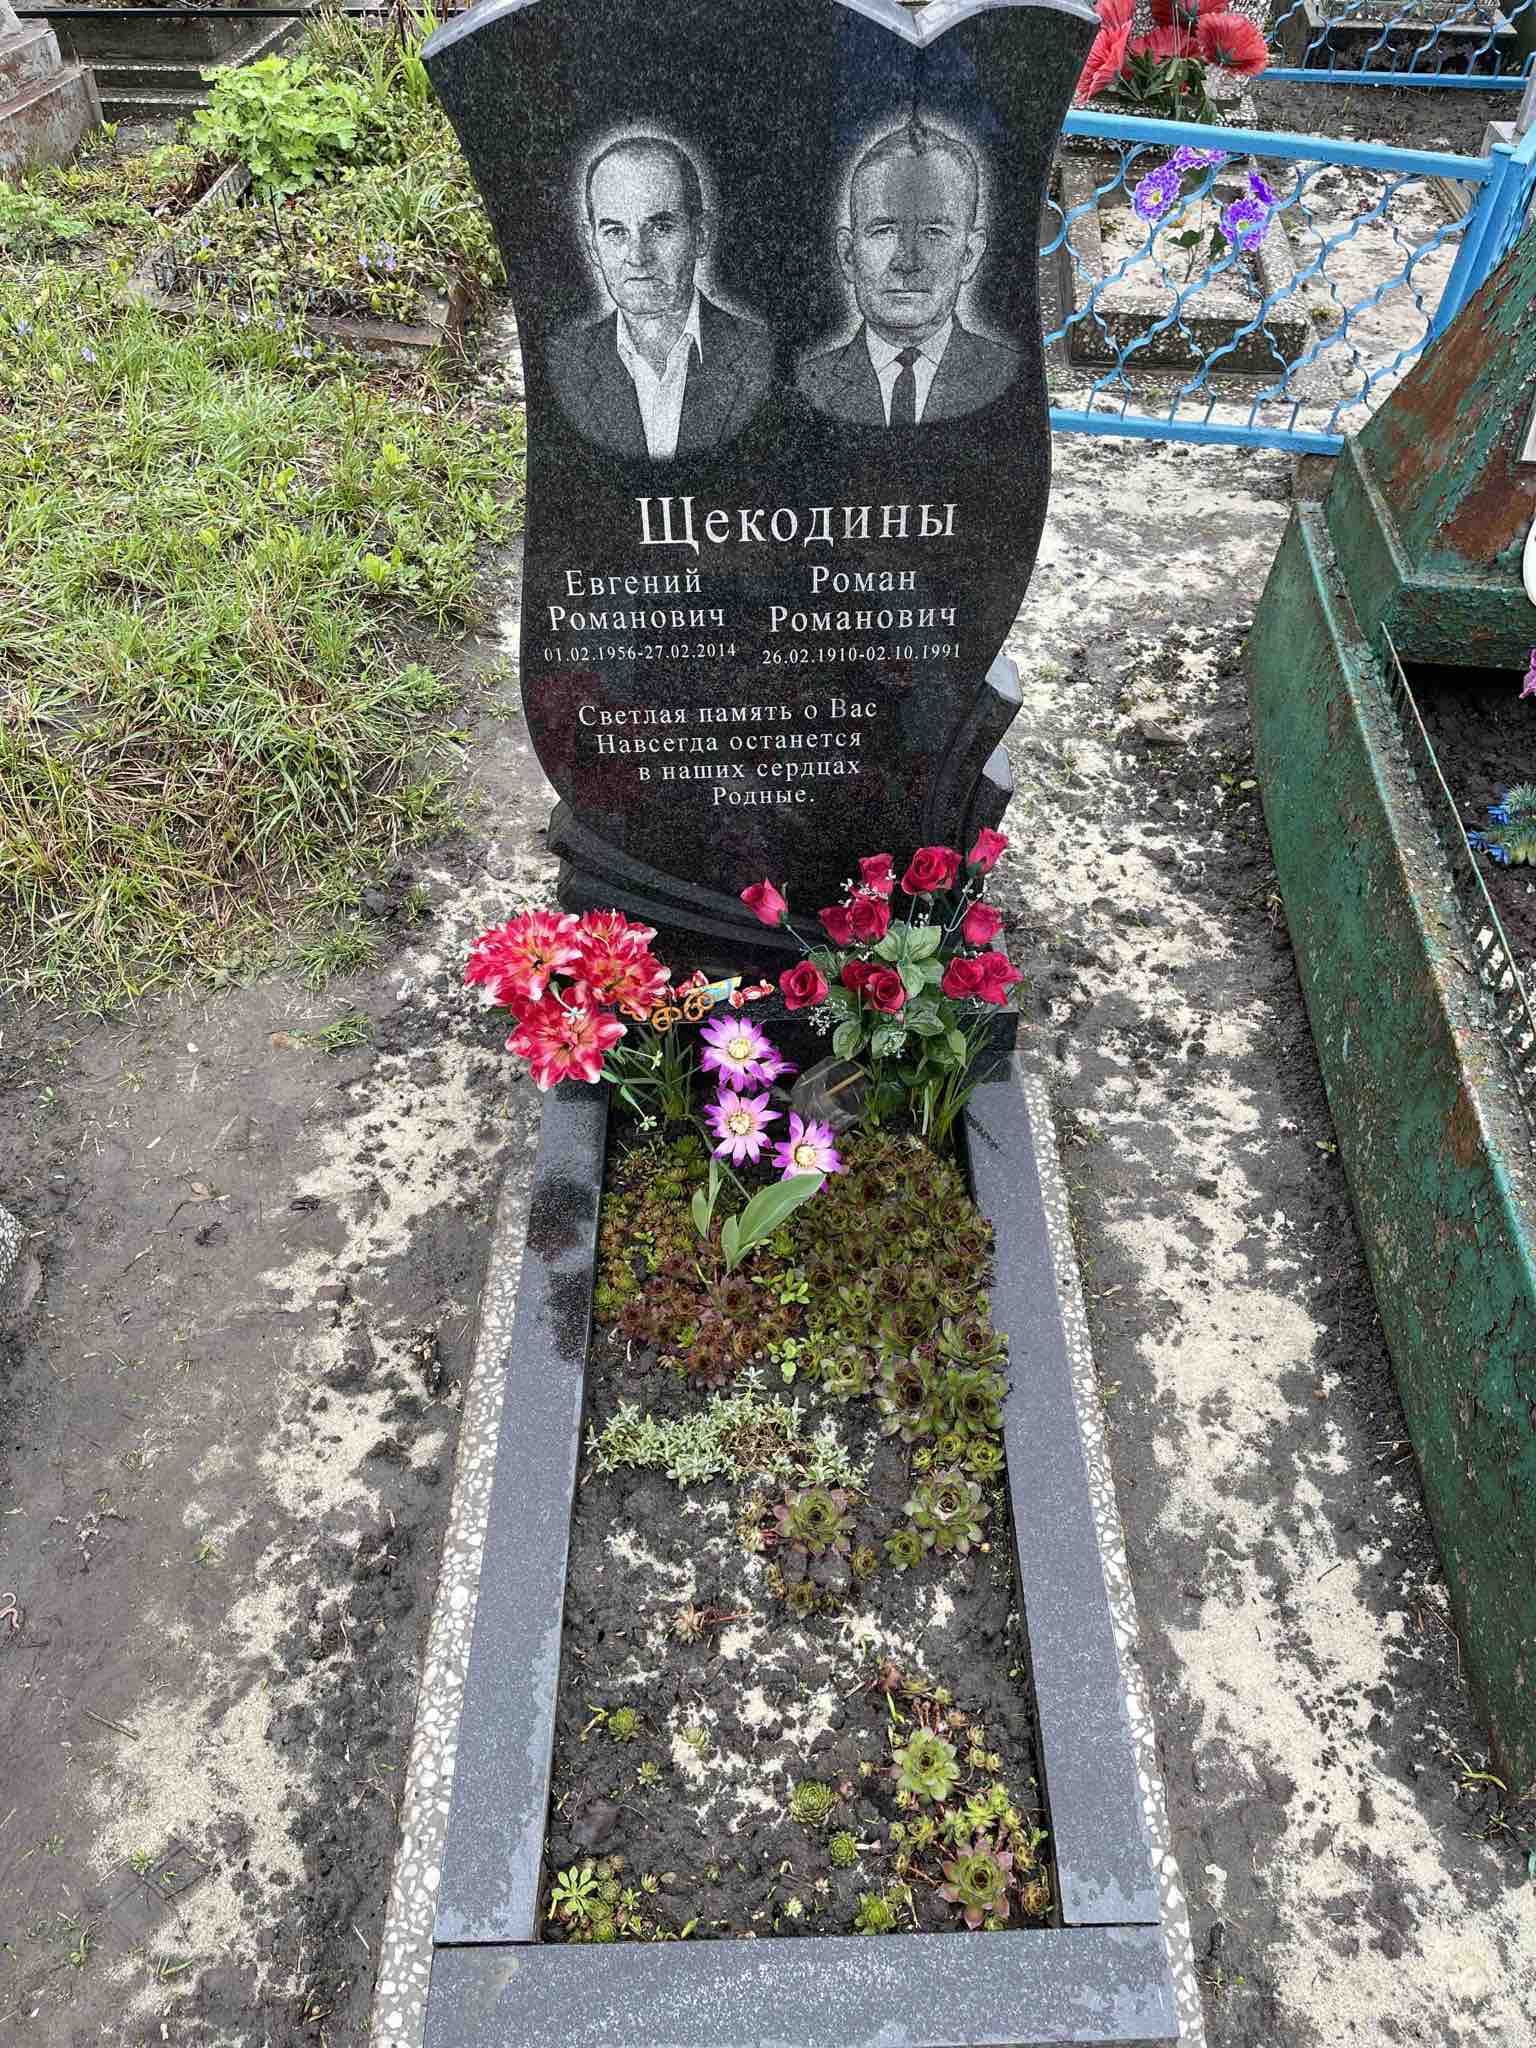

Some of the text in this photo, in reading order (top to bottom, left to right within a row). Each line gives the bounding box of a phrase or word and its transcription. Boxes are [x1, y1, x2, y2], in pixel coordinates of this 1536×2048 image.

[634, 496, 959, 557] Щекодины
[564, 567, 703, 598] Евгений
[810, 565, 918, 594] Роман
[548, 605, 726, 633] Романович
[769, 606, 957, 633] Романович
[543, 643, 737, 663] 01.02.1956-27.02.2014
[761, 643, 961, 665] 26.02.1910-02.10.1991
[578, 698, 878, 727] Светлая память о Вас
[596, 731, 862, 755] Навсегда останется
[638, 758, 861, 781] в наших сердцах
[712, 785, 816, 808] Родные.
